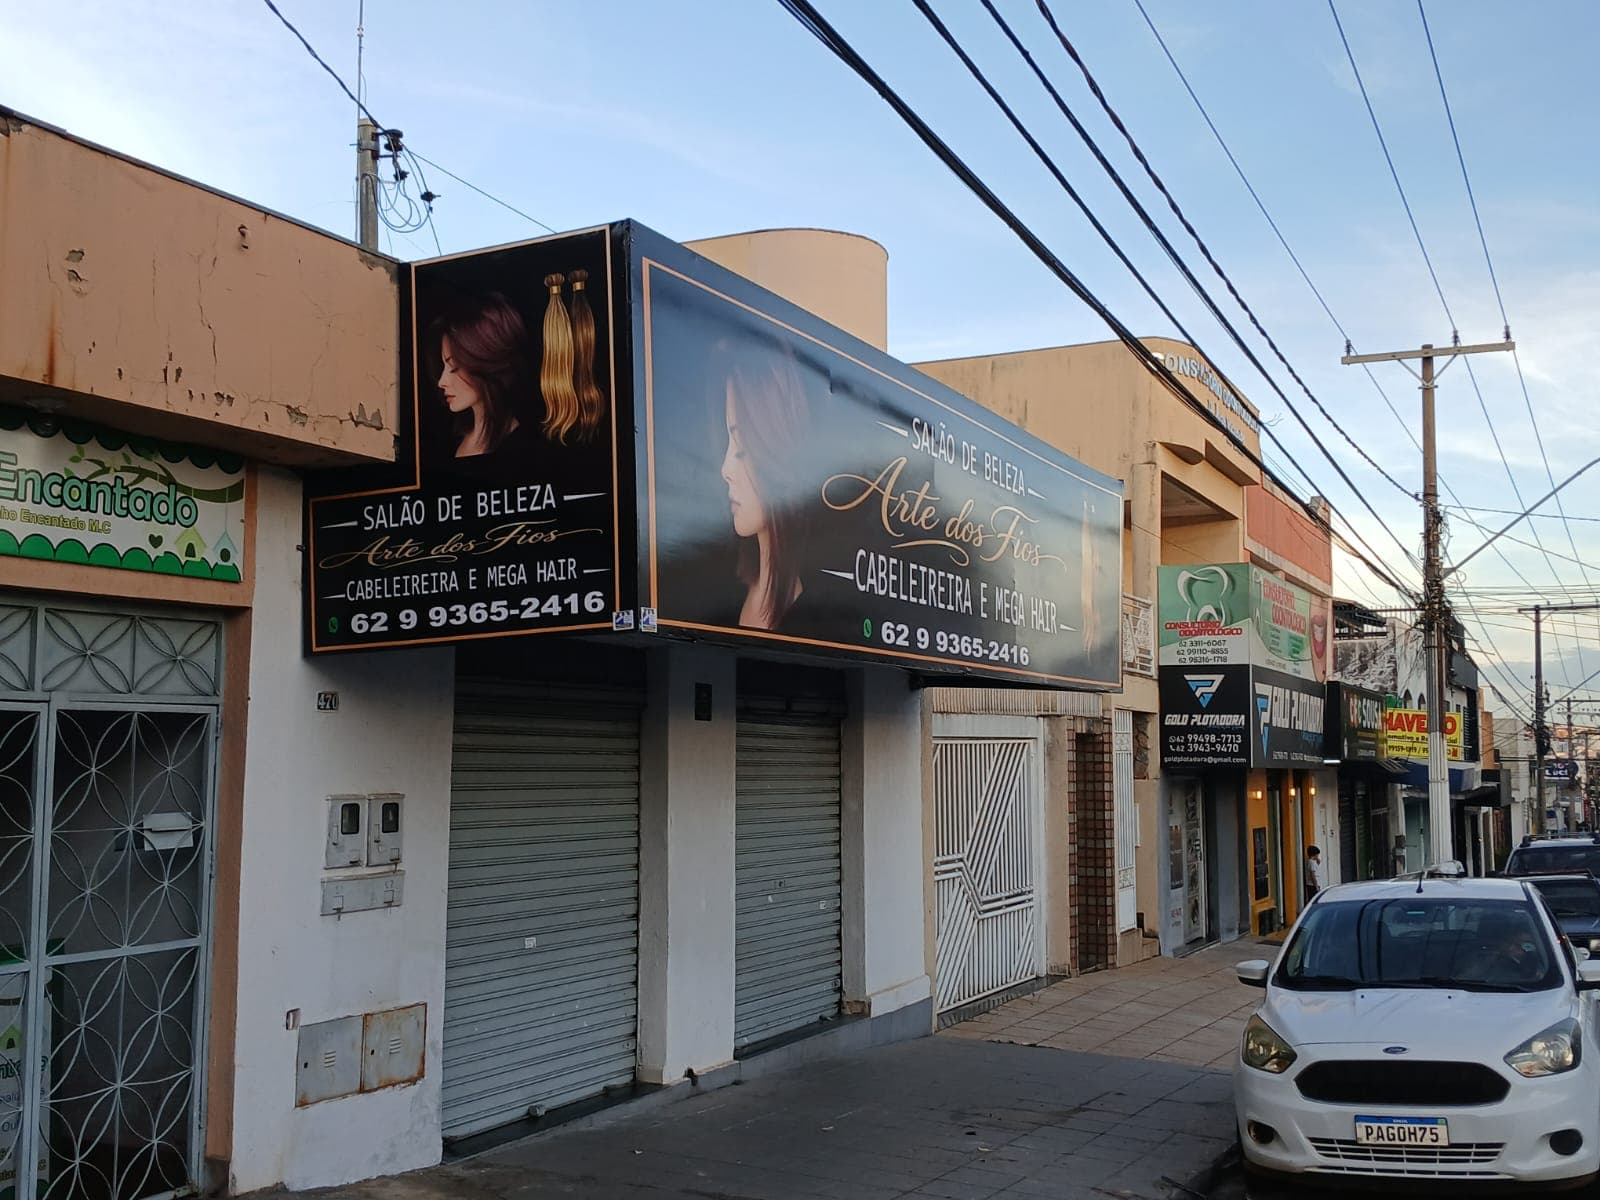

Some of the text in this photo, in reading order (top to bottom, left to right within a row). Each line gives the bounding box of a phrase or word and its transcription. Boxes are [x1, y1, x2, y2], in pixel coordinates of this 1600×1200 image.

[911, 416, 1026, 497] SALÃO DE BELEZA
[0, 452, 198, 528] Encantado
[363, 483, 556, 531] SALÃO DE BELEZA
[21, 509, 86, 530] Encantado
[822, 456, 1067, 572] Arte dos Fios
[319, 519, 603, 569] Arte dos Fios
[346, 558, 577, 601] CABELEIREIRA E MEGA HAIR
[855, 548, 1058, 635] CABELEIREIRA E MEGA HAIR
[351, 612, 389, 634] 62
[399, 609, 418, 630] 9
[429, 591, 606, 627] 9365-2416
[881, 621, 1029, 666] 62 9 9365-2416
[1164, 714, 1245, 726] GOLD PLOTADORA
[1187, 733, 1242, 743] 99498-7713
[1176, 743, 1239, 752] 62 3943-9470
